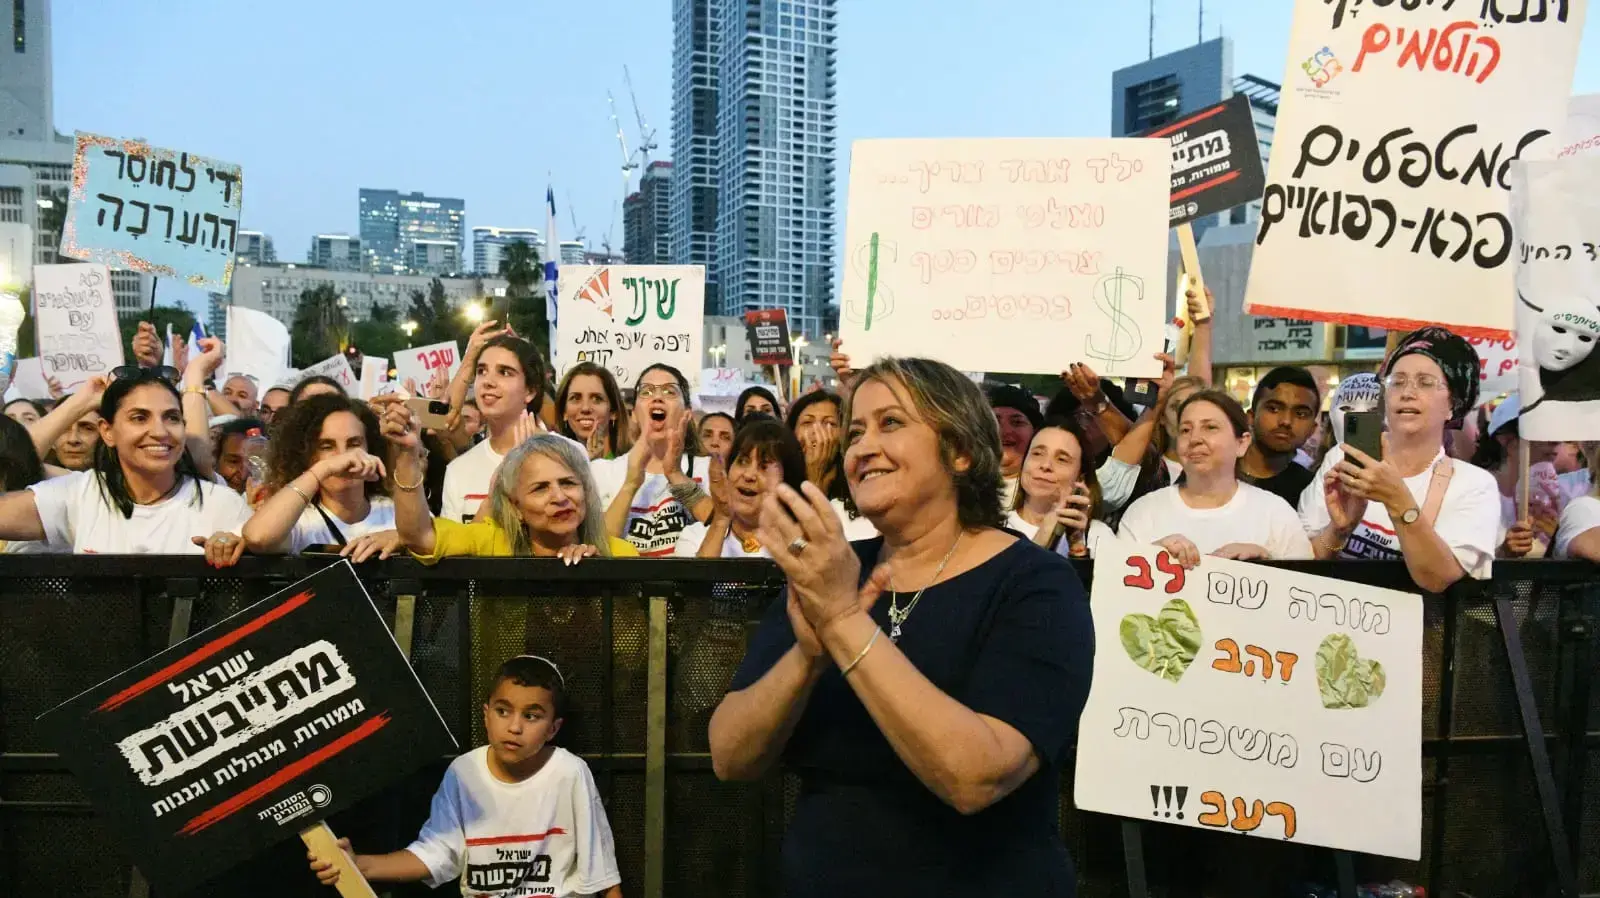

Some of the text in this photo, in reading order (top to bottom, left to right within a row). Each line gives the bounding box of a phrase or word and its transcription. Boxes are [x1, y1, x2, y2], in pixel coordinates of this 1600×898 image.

[1351, 21, 1501, 84] הולמים
[1172, 136, 1224, 163] מתיי
[1292, 124, 1551, 190] למטפלים
[1000, 158, 1070, 183] אחד
[1086, 152, 1143, 183] ילד
[911, 204, 1000, 229] מורים
[910, 249, 1102, 284] צריכים כסף
[622, 277, 681, 326] שינוי
[1287, 327, 1313, 338] בית
[650, 536, 679, 549] נהלות
[1364, 527, 1392, 545] ישראל
[1123, 551, 1391, 635] מורה עם לב
[167, 650, 255, 703] ישראל
[140, 651, 341, 776] מתייבשת
[152, 698, 366, 818] ממורות, מנהלות וגננות
[1113, 707, 1382, 783] עם משכורת
[257, 791, 306, 820] הסתדרות
[273, 798, 310, 821] המורים
[496, 848, 531, 860] ישראל
